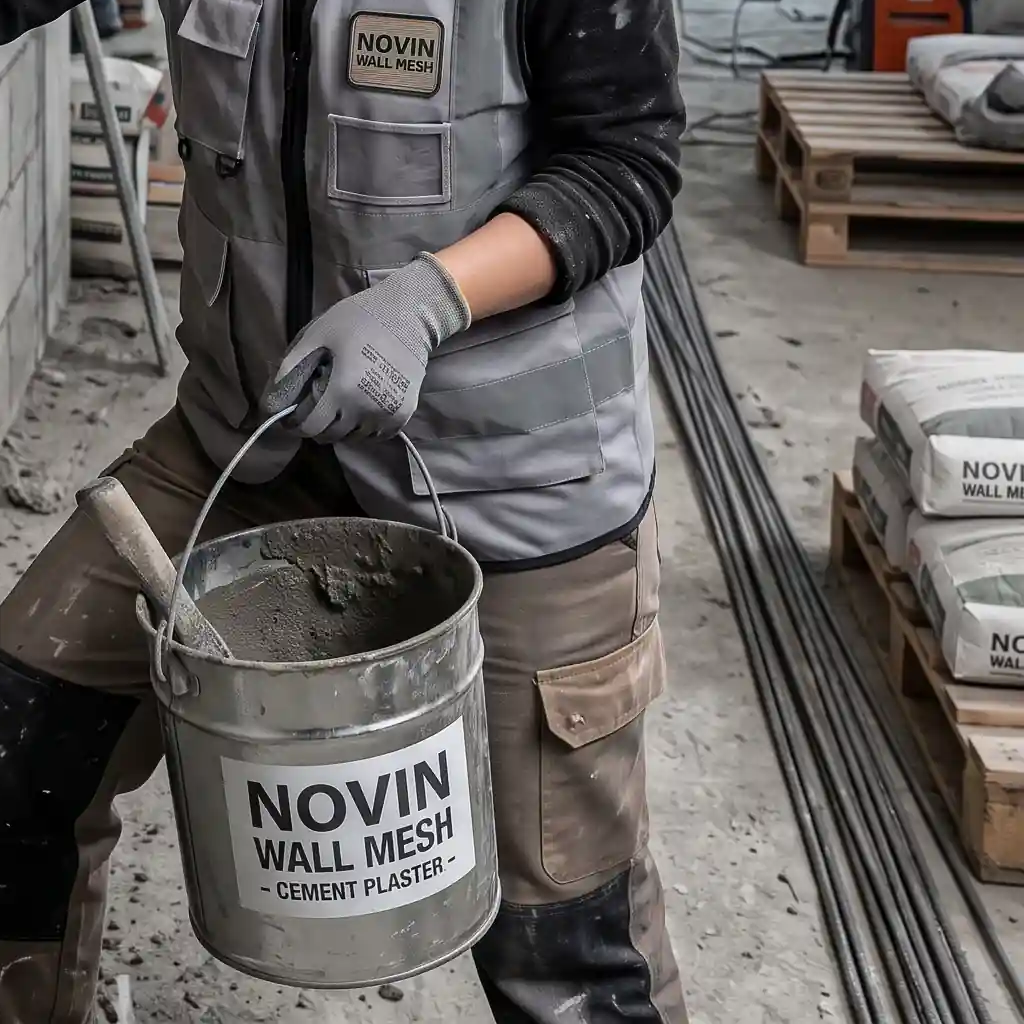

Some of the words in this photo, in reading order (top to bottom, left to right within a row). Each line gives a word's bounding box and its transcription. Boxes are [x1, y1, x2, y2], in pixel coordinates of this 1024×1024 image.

[357, 32, 435, 58] NOVIN
[356, 54, 392, 69] WALL
[396, 58, 434, 73] MESH
[962, 482, 1002, 498] WALL
[247, 749, 451, 832] NOVIN
[252, 836, 355, 874] WALL
[363, 805, 454, 869] MESH
[276, 880, 358, 902] CEMENT
[363, 855, 444, 897] PLASTER
